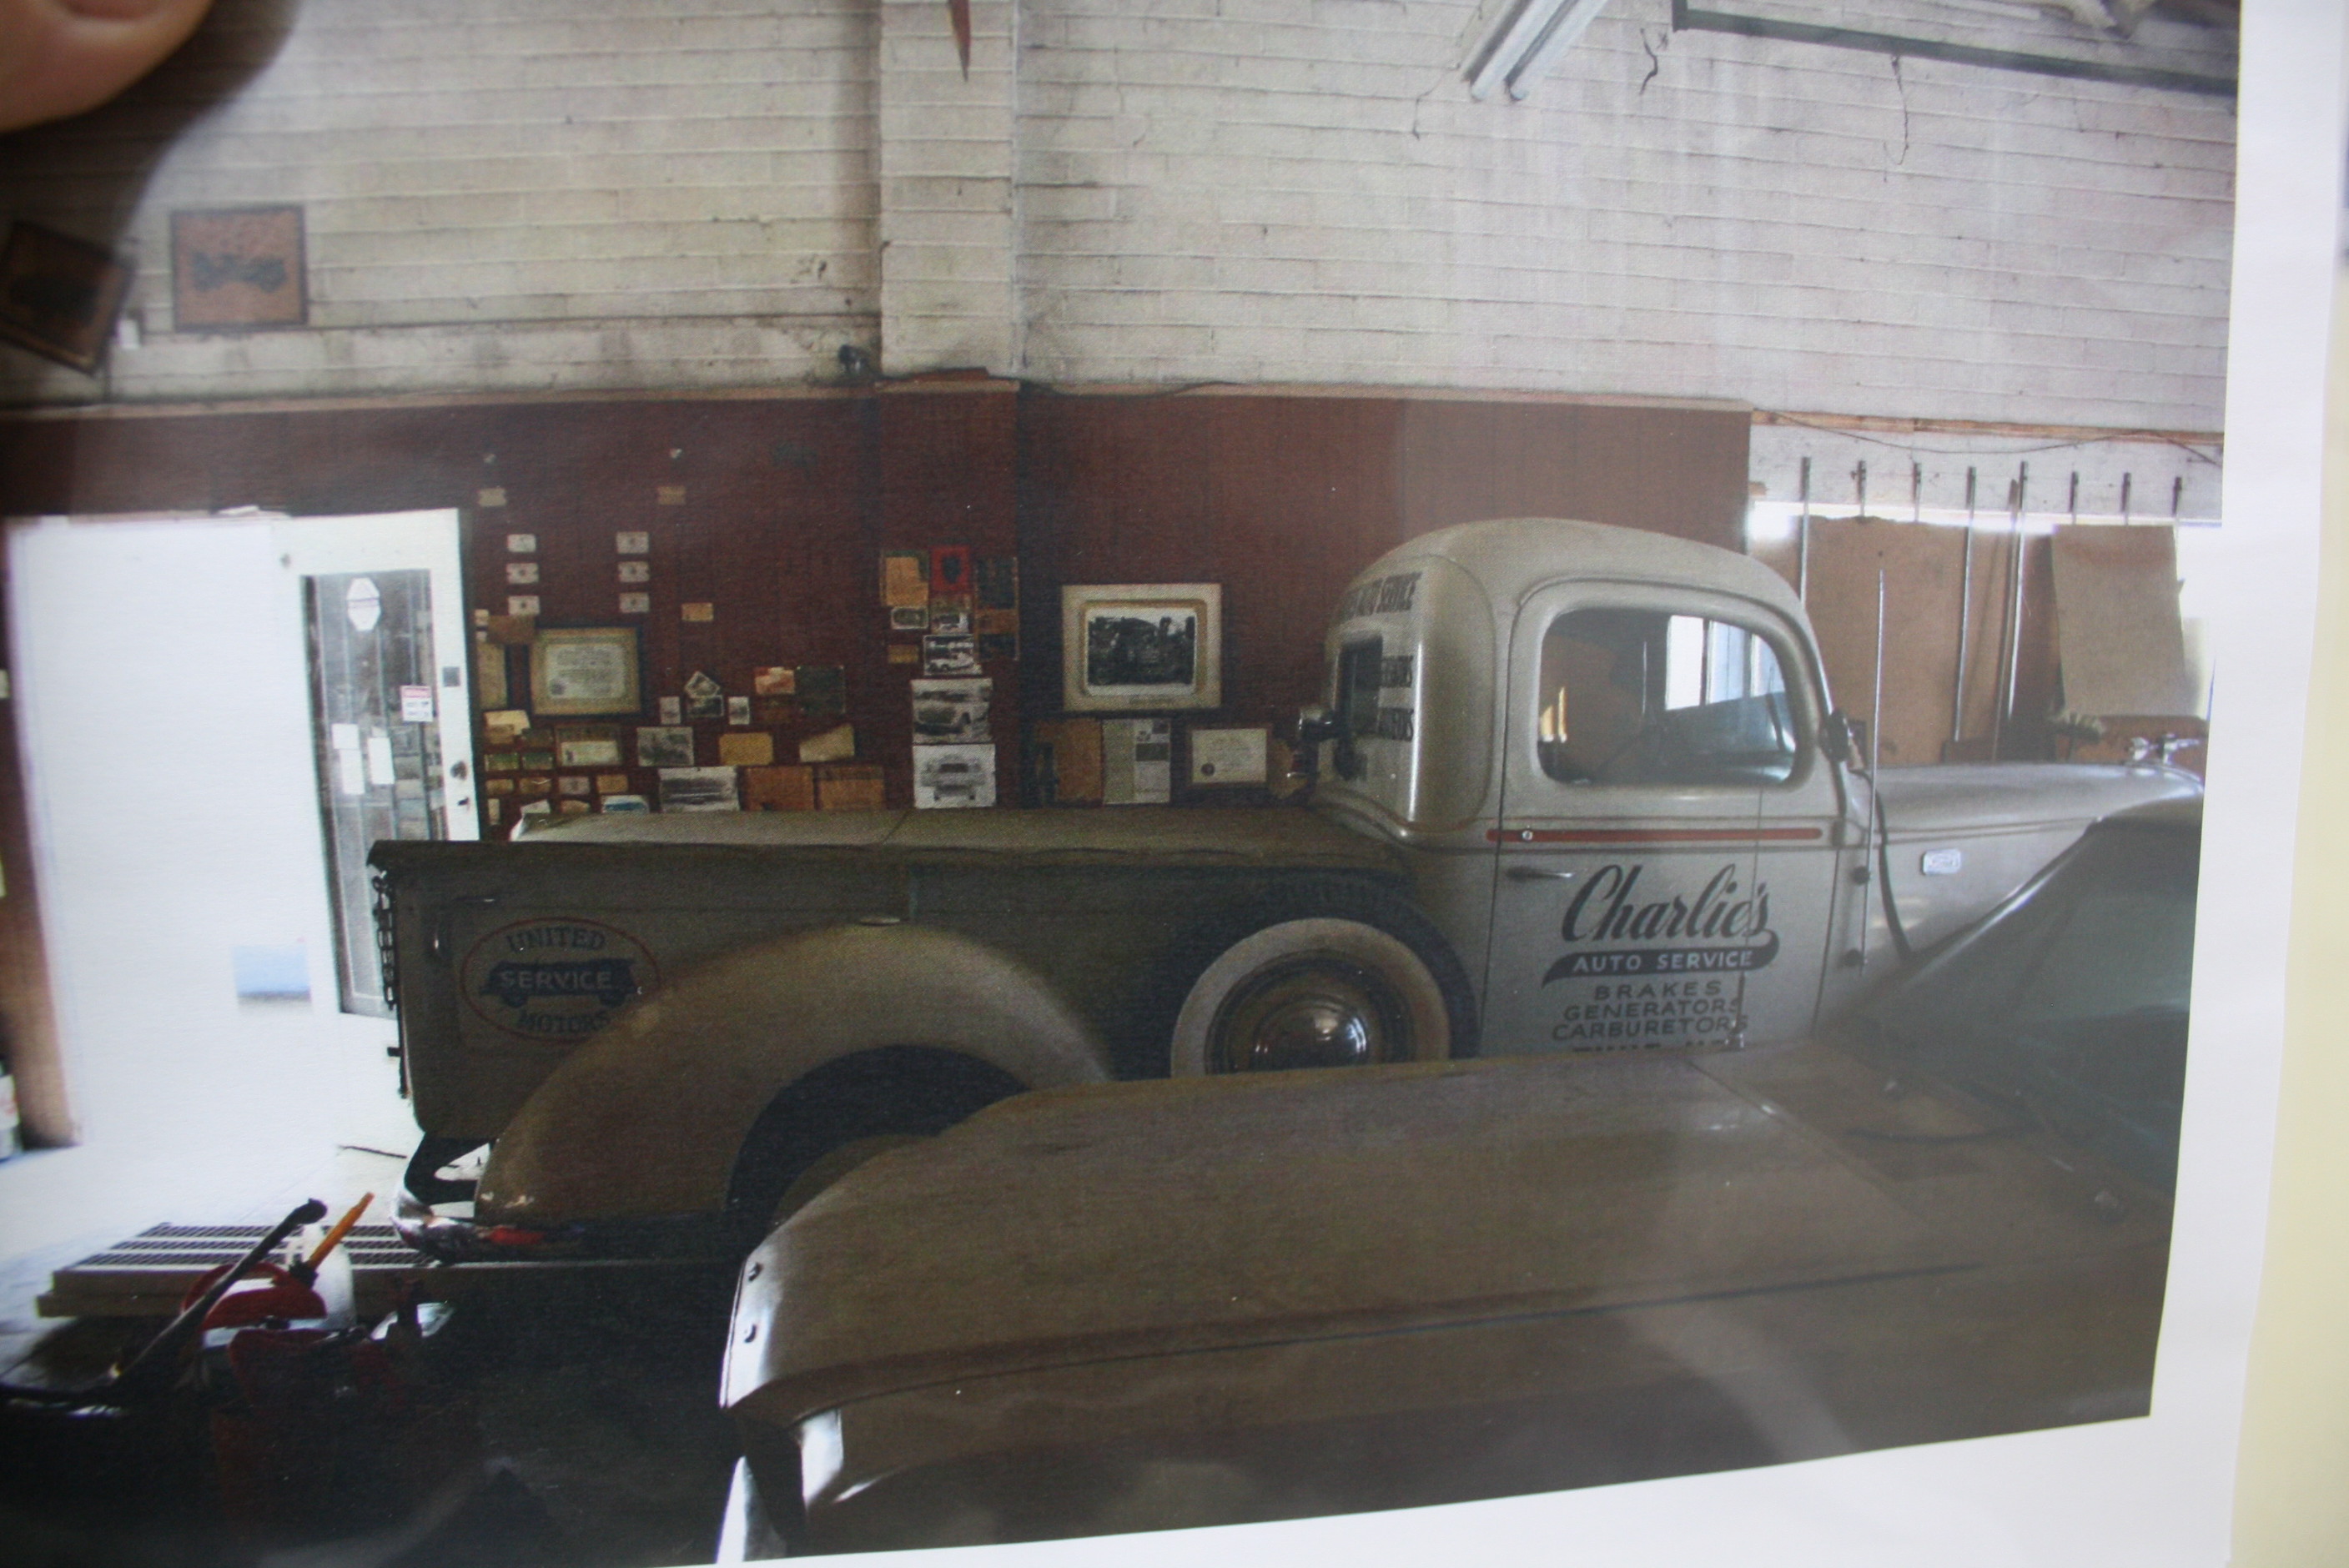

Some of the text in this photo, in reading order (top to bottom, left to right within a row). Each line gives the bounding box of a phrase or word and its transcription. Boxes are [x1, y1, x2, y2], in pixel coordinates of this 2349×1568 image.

[1562, 863, 1769, 942] Charlie's
[506, 927, 606, 952] UNITED
[1573, 951, 1753, 972] AUTO SERVICE
[499, 969, 612, 989] SERVICE
[1595, 980, 1722, 1001] BRAKES
[517, 1009, 611, 1033] MOTORS
